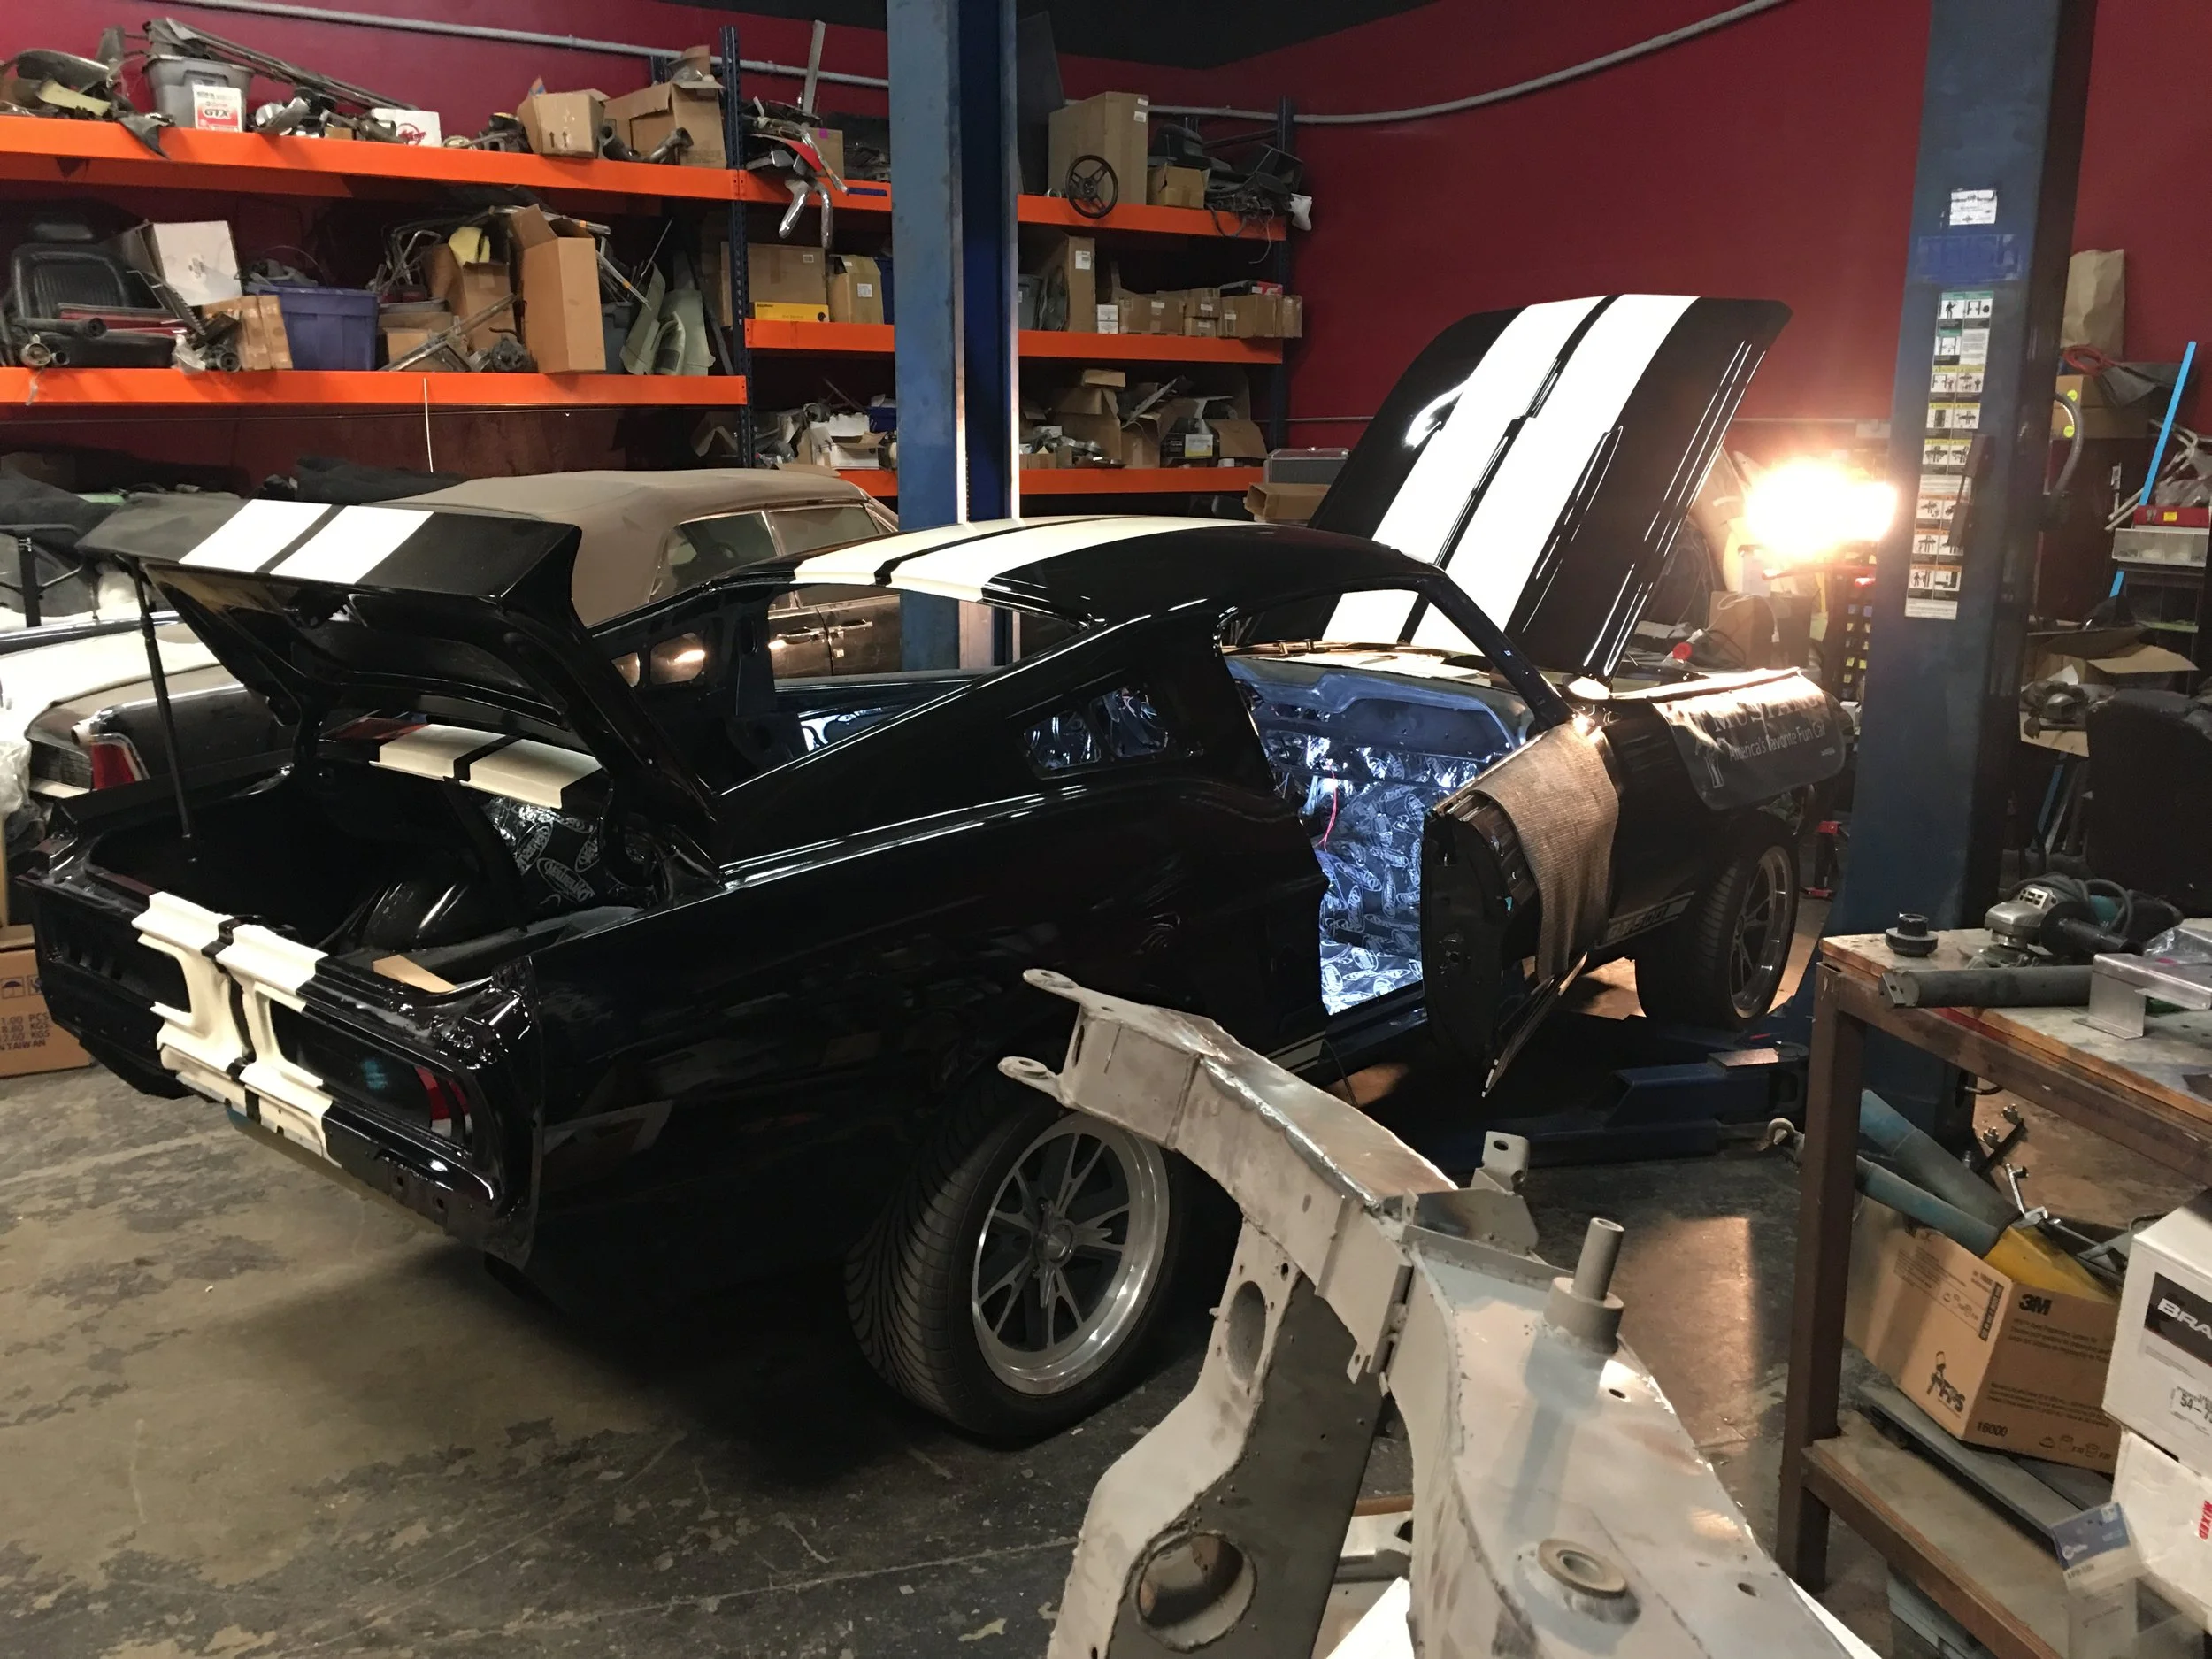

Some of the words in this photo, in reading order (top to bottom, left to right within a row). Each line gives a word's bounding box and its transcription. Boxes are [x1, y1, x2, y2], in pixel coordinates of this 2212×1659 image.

[1729, 736, 1767, 762] America's
[1767, 733, 1797, 753] Favorite
[1796, 726, 1812, 743] Fun
[1813, 719, 1827, 740] Car
[29, 1013, 49, 1023] PCS
[7, 1039, 46, 1050] TAIWAN
[2019, 1294, 2052, 1316] 3M
[1977, 1421, 2008, 1437] 16000
